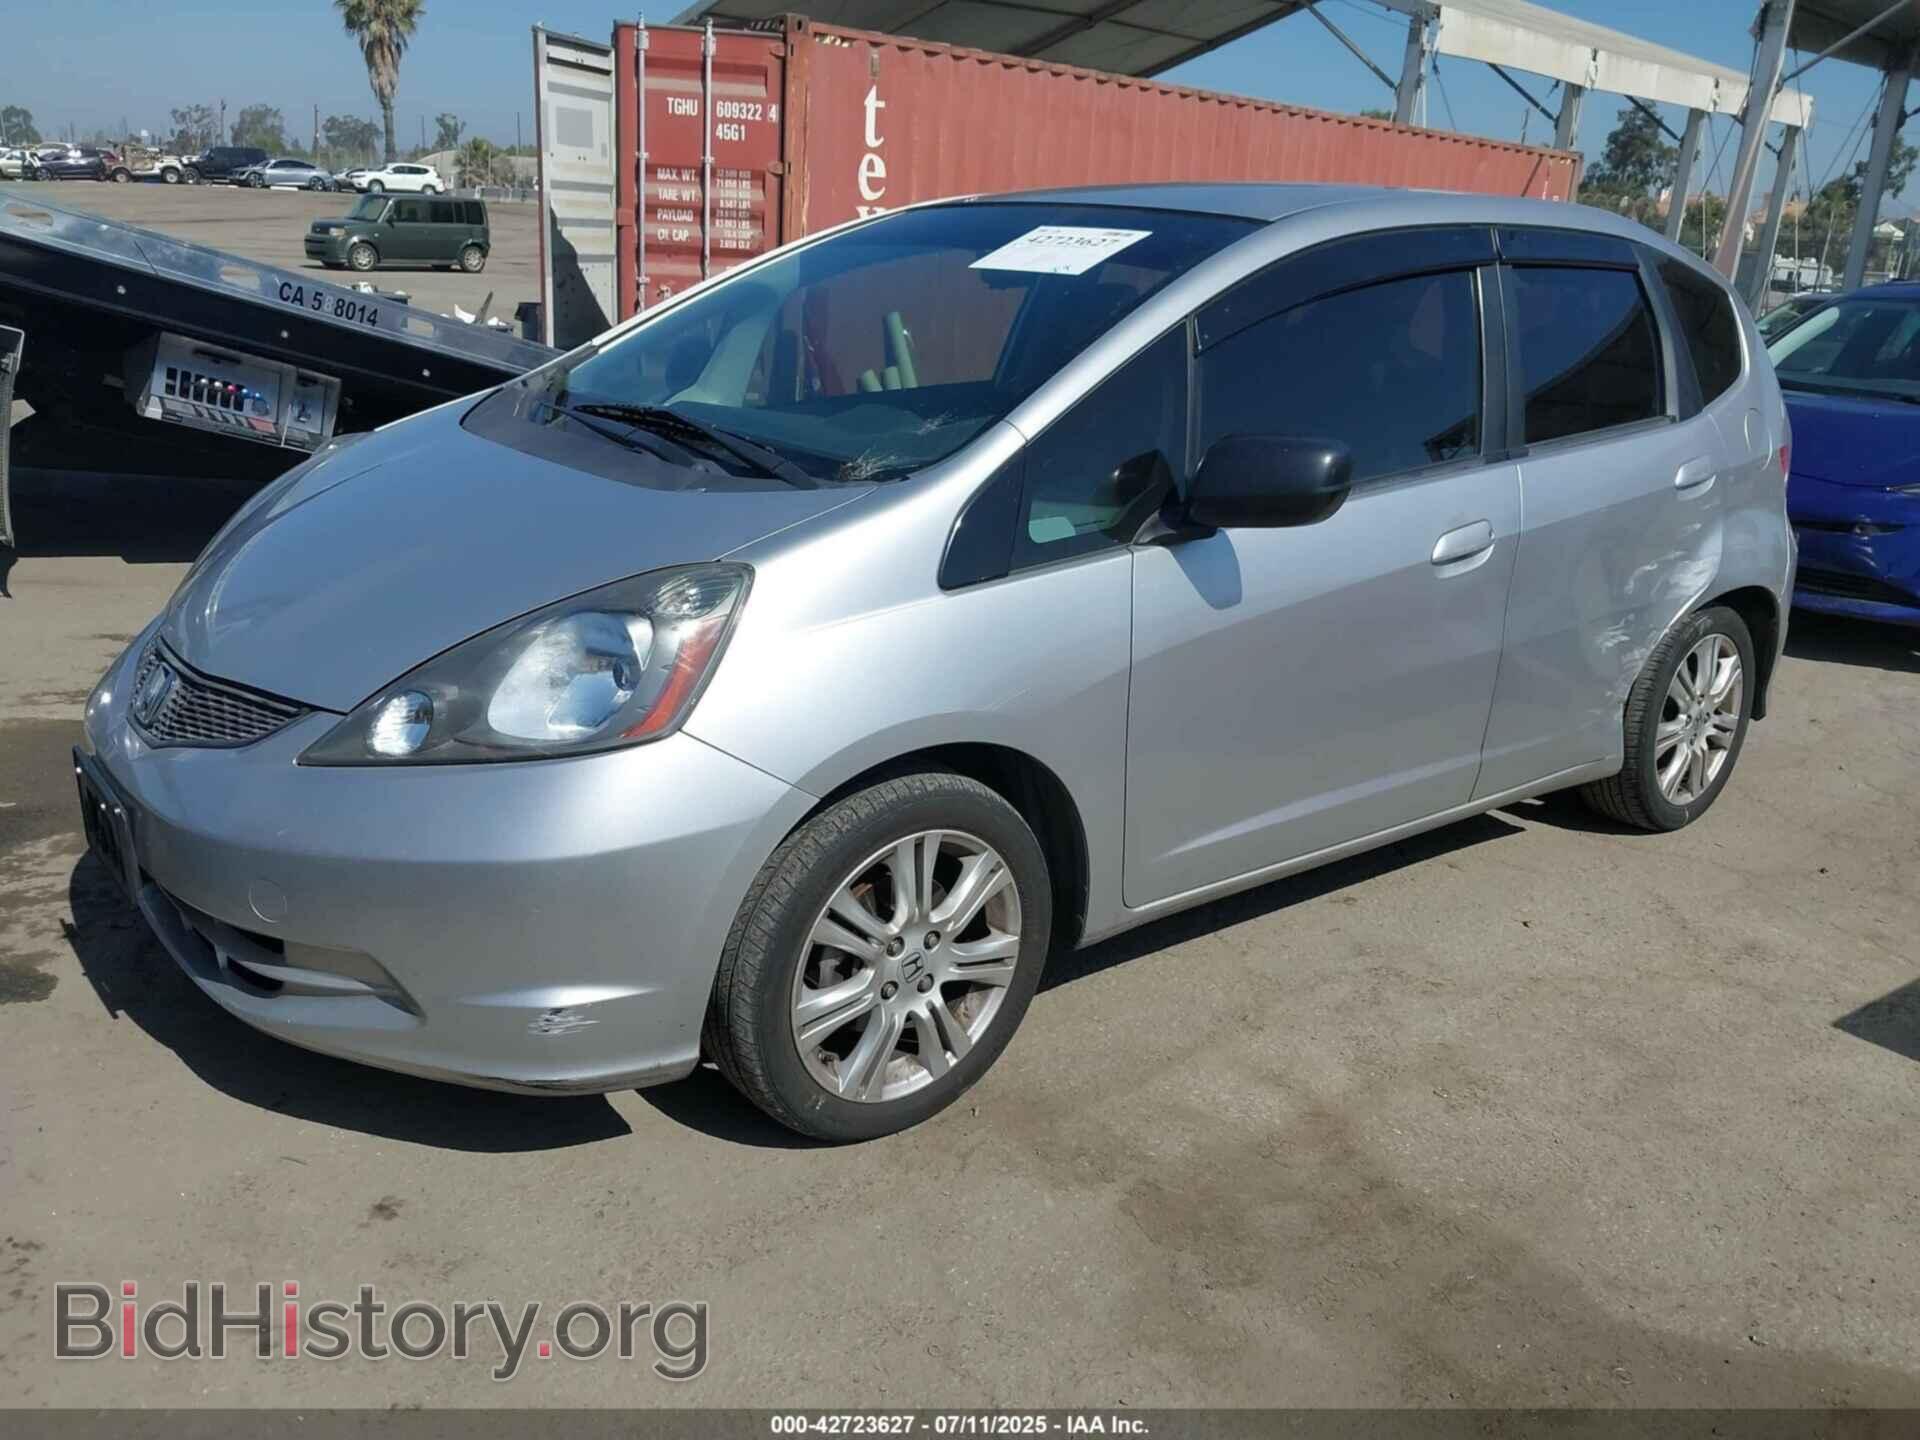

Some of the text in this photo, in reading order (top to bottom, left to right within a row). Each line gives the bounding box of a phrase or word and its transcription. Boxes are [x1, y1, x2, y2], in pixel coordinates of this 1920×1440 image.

[666, 97, 778, 123] TGHU 609322 4
[715, 123, 746, 141] 45G1
[857, 84, 887, 219] te
[657, 207, 694, 222] PAYLOAD
[279, 282, 304, 307] CA
